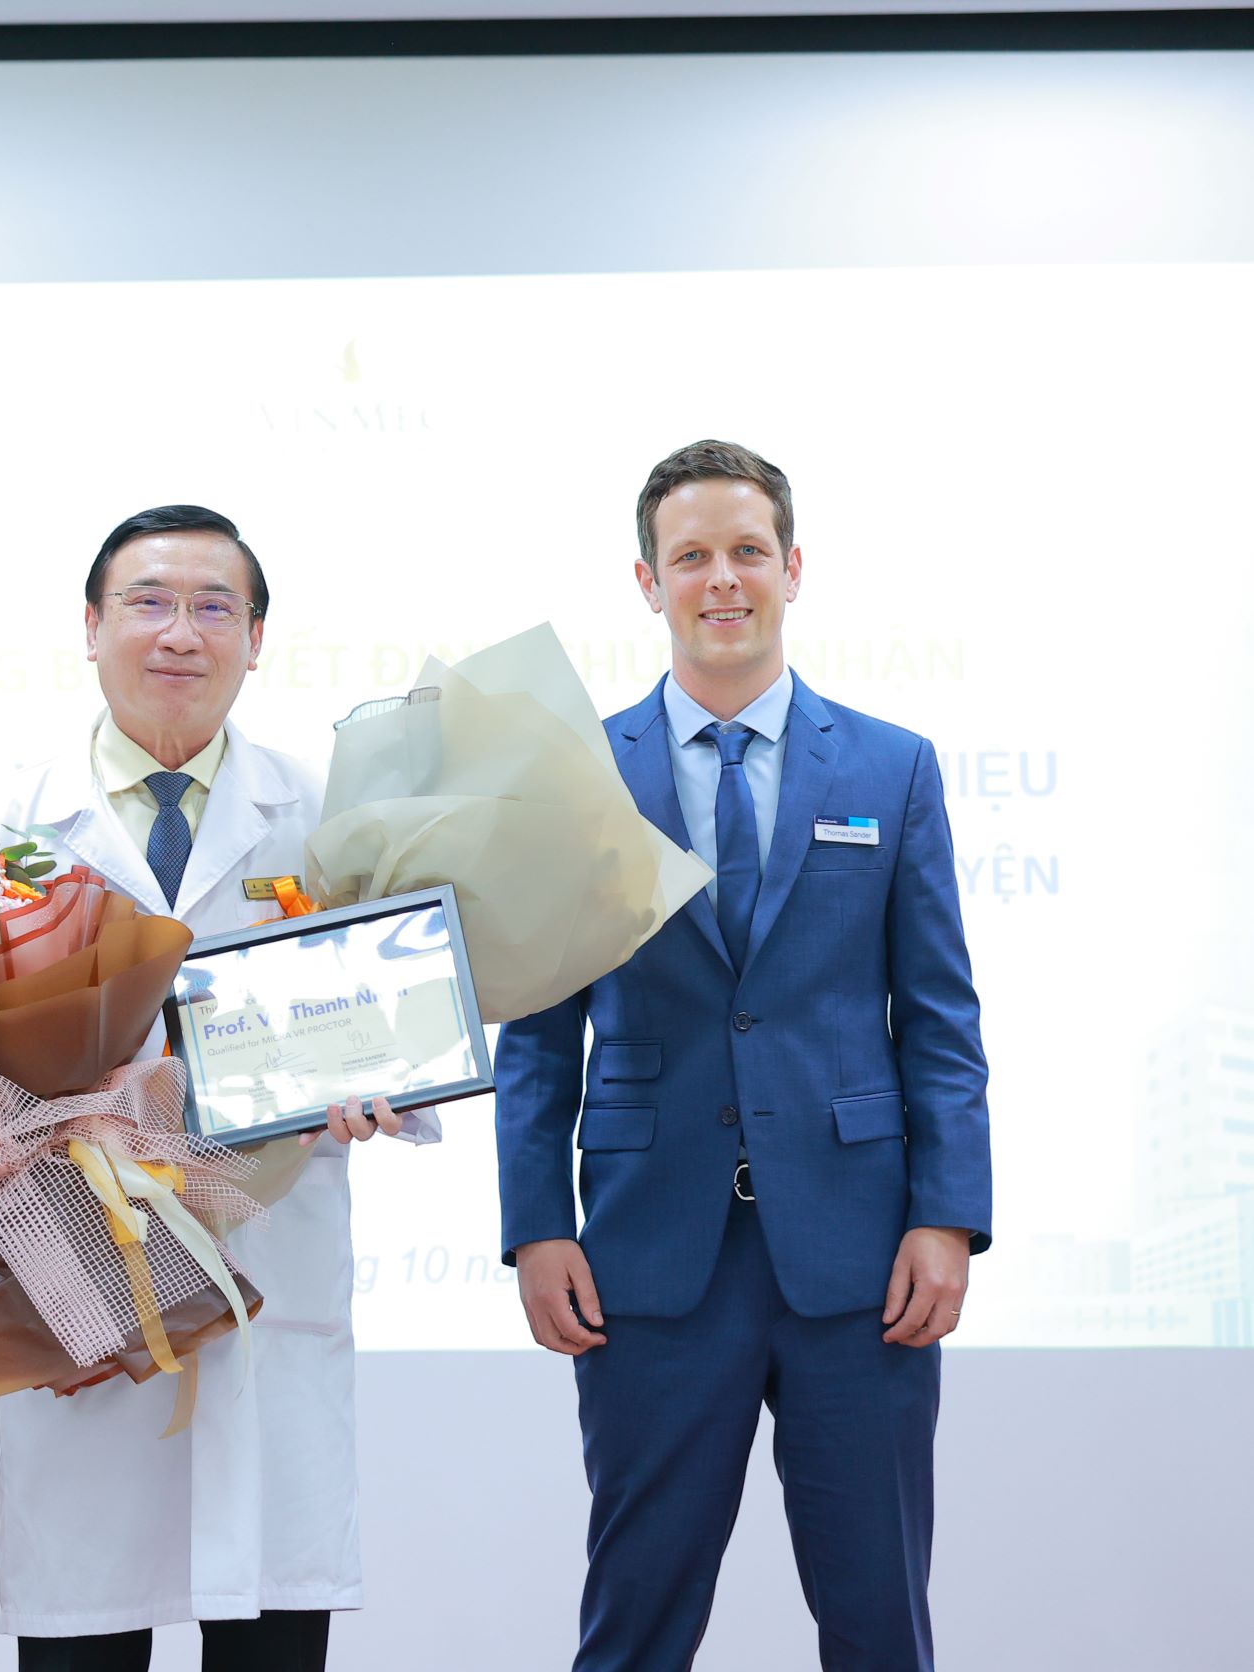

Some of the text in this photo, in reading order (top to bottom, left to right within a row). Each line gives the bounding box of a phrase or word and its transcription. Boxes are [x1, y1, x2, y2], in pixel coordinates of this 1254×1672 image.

[50, 648, 83, 692] B
[823, 828, 873, 839] Thomas Sander
[955, 841, 1060, 904] YỆN
[203, 1015, 252, 1041] Prof.
[289, 996, 350, 1021] Thanh
[207, 1041, 246, 1057] Qualified
[247, 1037, 260, 1049] for
[307, 1017, 352, 1035] PROCTOR
[401, 1245, 450, 1285] 10
